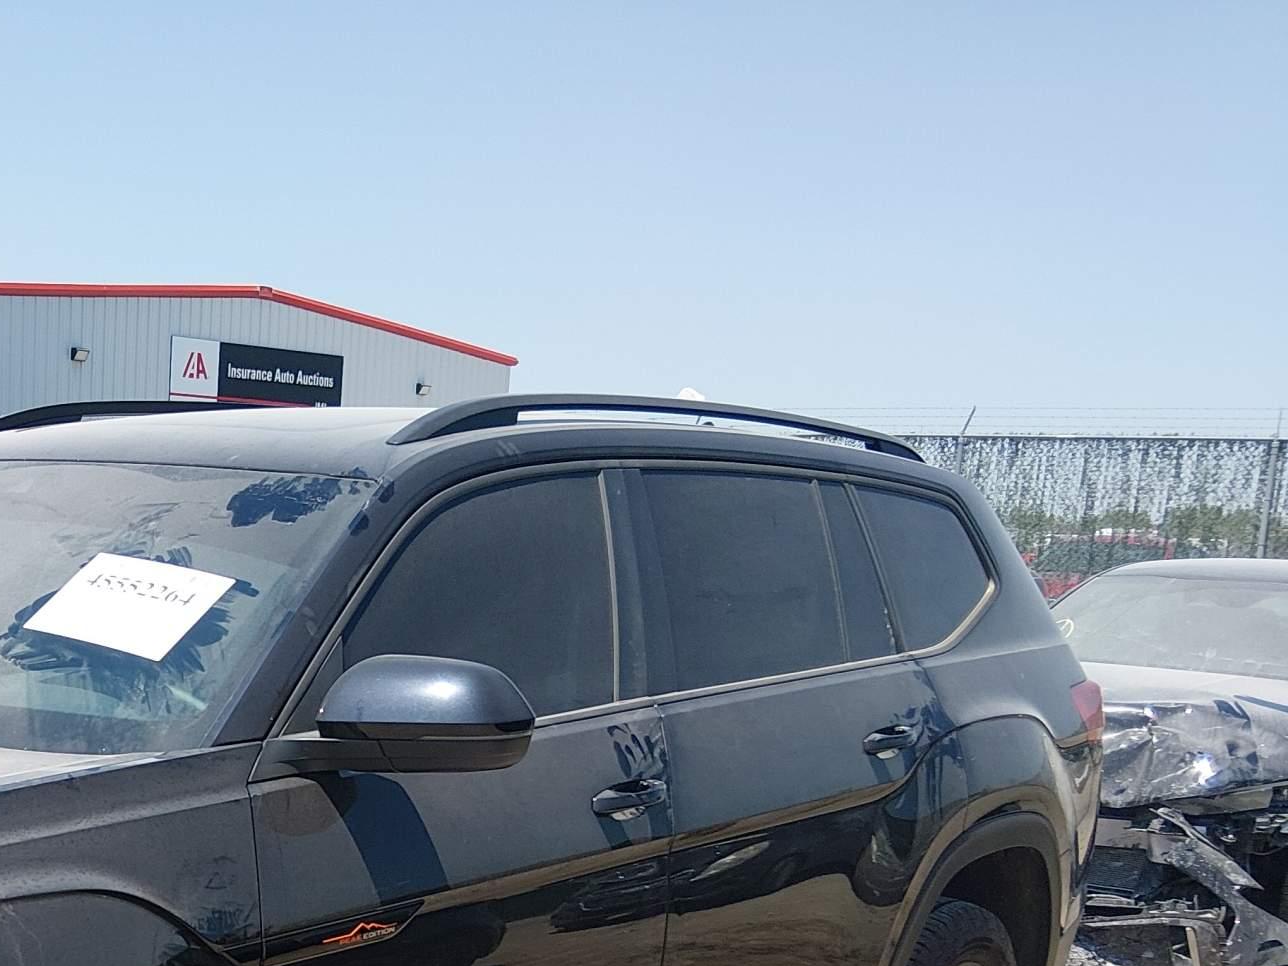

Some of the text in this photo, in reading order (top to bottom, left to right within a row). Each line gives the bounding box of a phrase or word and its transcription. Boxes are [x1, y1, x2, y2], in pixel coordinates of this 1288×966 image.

[227, 362, 334, 388] Insurance Auto Auctions
[362, 926, 396, 939] EDITION
